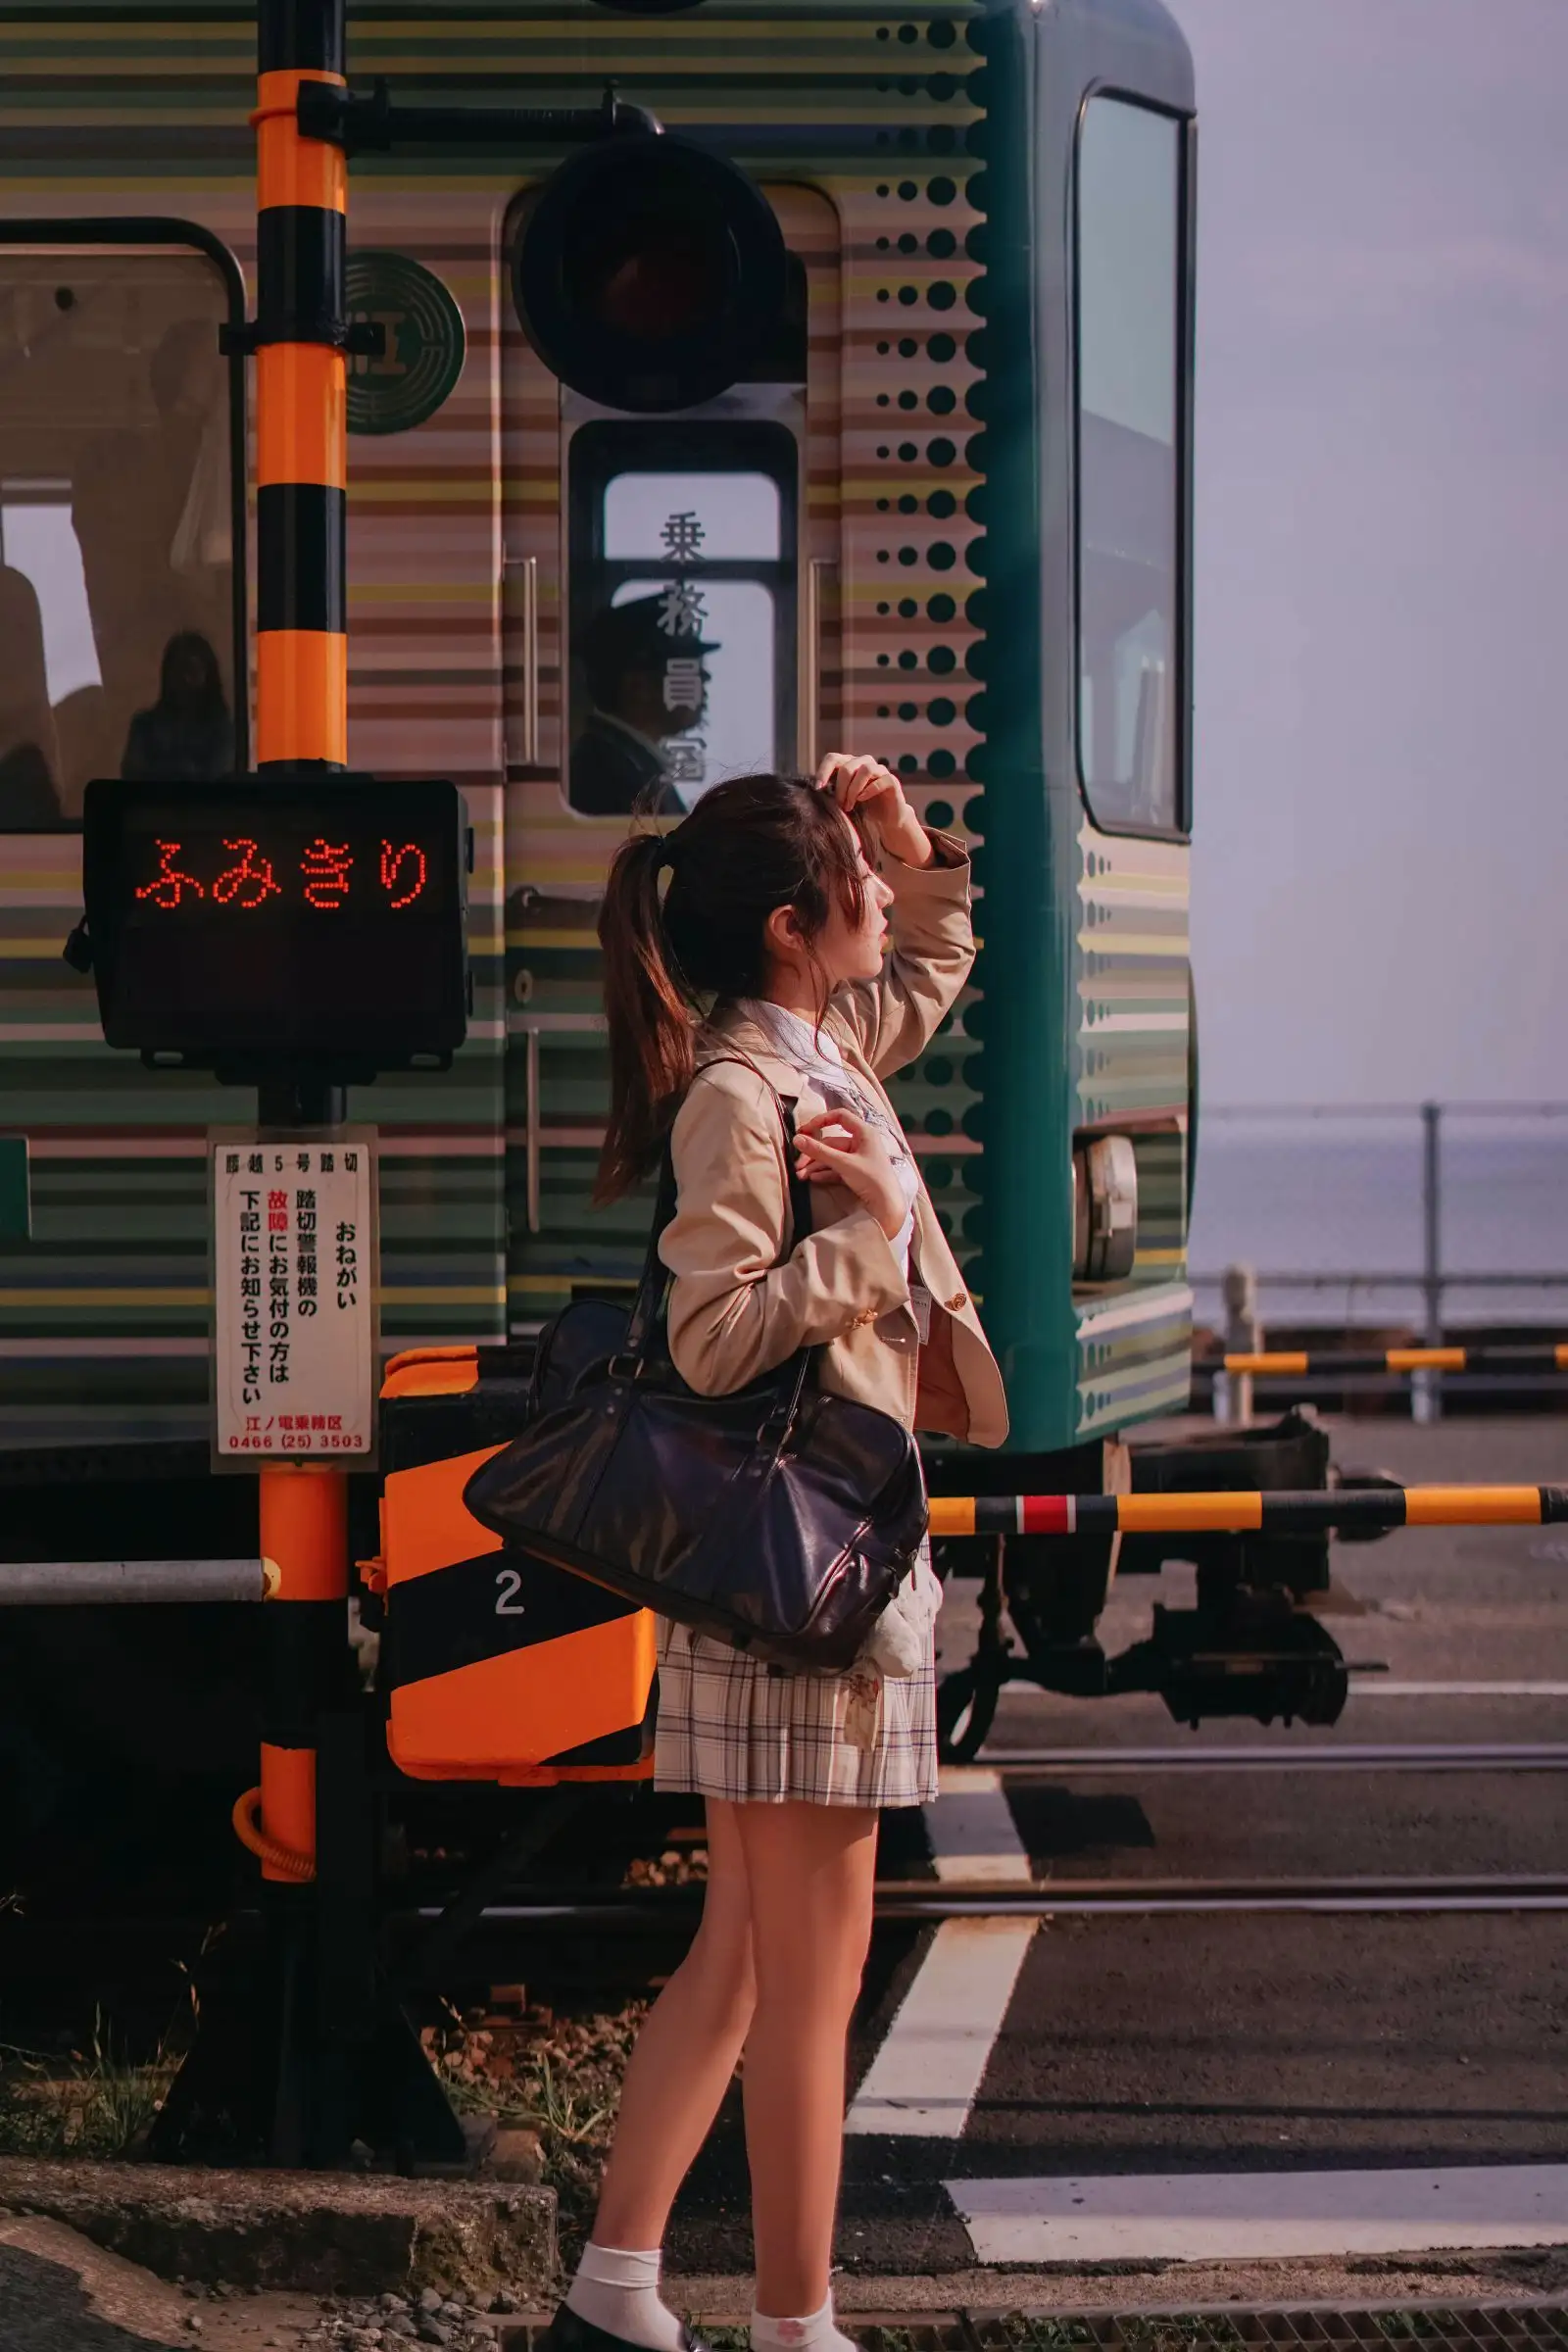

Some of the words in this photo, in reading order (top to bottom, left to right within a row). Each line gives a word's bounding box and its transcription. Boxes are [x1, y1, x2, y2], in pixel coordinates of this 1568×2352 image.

[135, 839, 427, 907] ふみきり
[239, 1191, 262, 1404] 下記にお知らせ下さい
[267, 1189, 290, 1383] 故障にお気付の方は
[296, 1189, 318, 1317] 踏切警報機の
[336, 1222, 358, 1310] おねがい
[495, 1569, 525, 1615] 2
